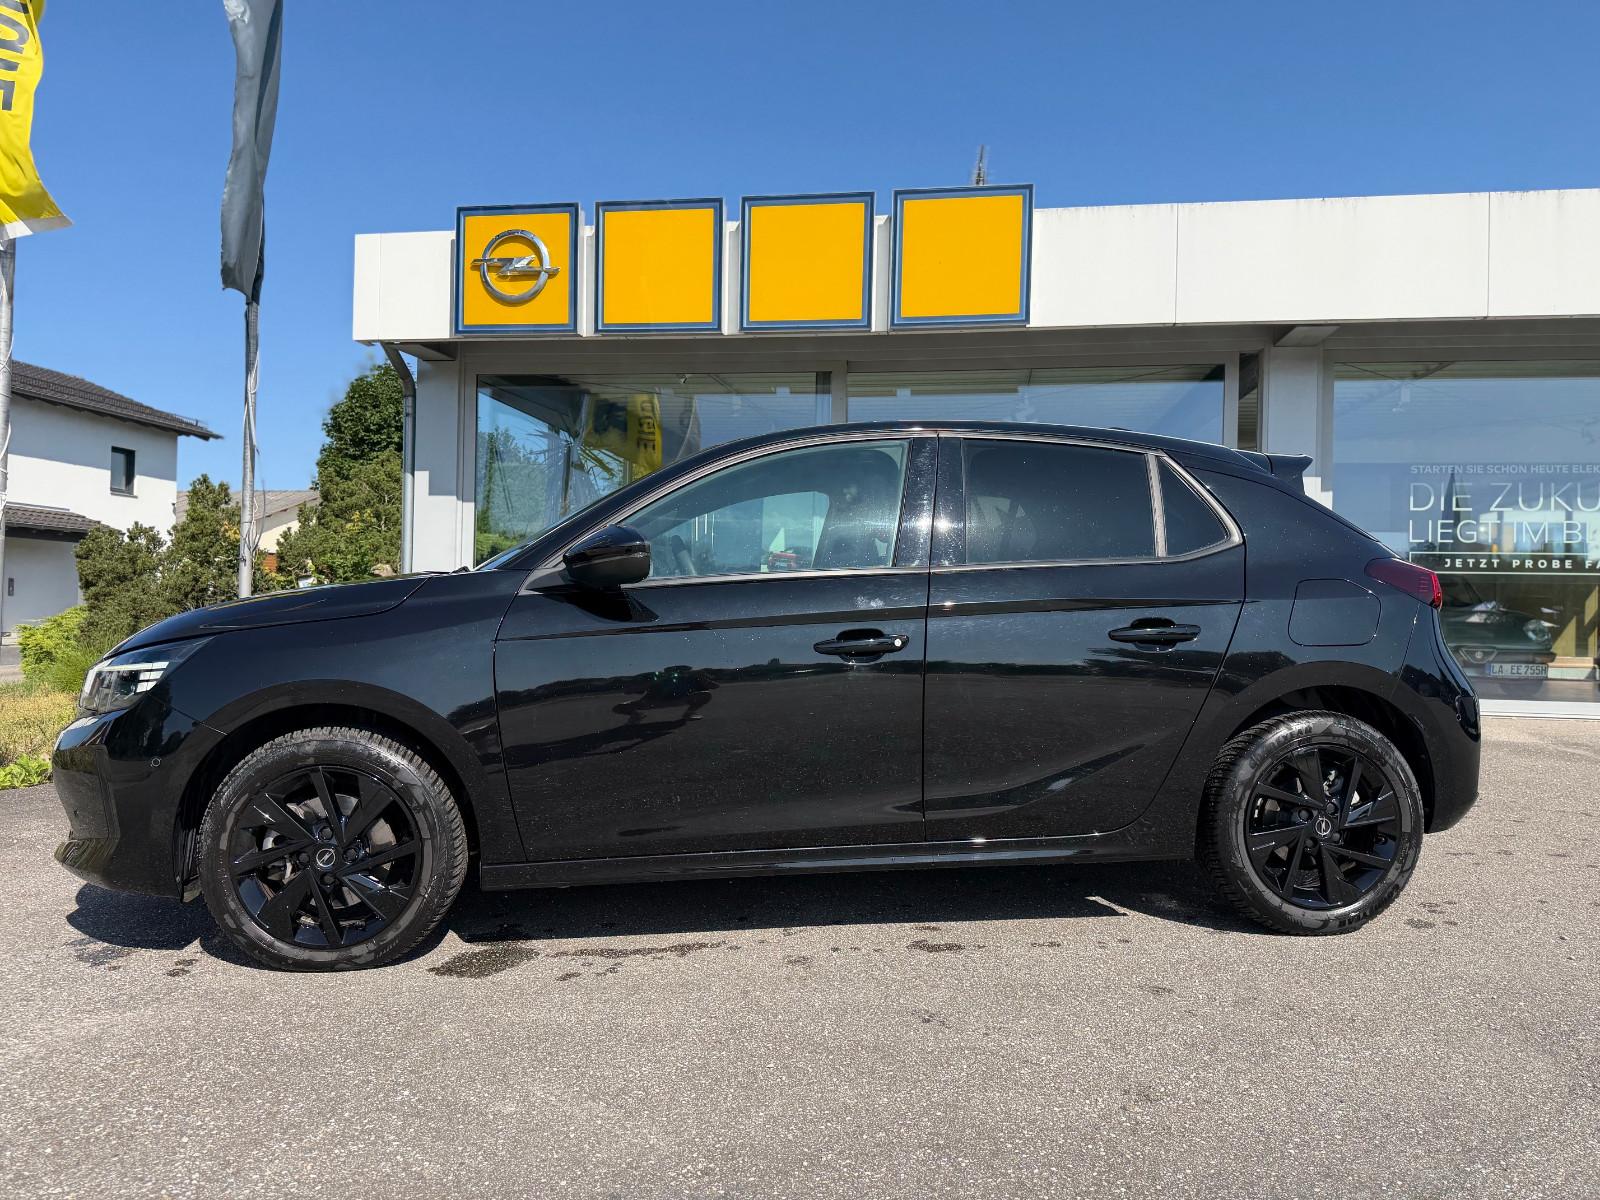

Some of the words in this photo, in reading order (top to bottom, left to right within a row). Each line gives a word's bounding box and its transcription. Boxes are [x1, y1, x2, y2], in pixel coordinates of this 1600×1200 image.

[1410, 464, 1463, 474] STARTEN
[1465, 464, 1484, 474] SIE
[1487, 464, 1527, 474] SCHON
[1530, 464, 1569, 473] HEUTE
[1409, 482, 1473, 512] DIE
[1489, 482, 1600, 512] ZUKU
[1409, 519, 1500, 543] LIEGT
[1513, 520, 1549, 544] IM
[1444, 559, 1500, 568] JETZT
[1512, 559, 1573, 569] PROBE
